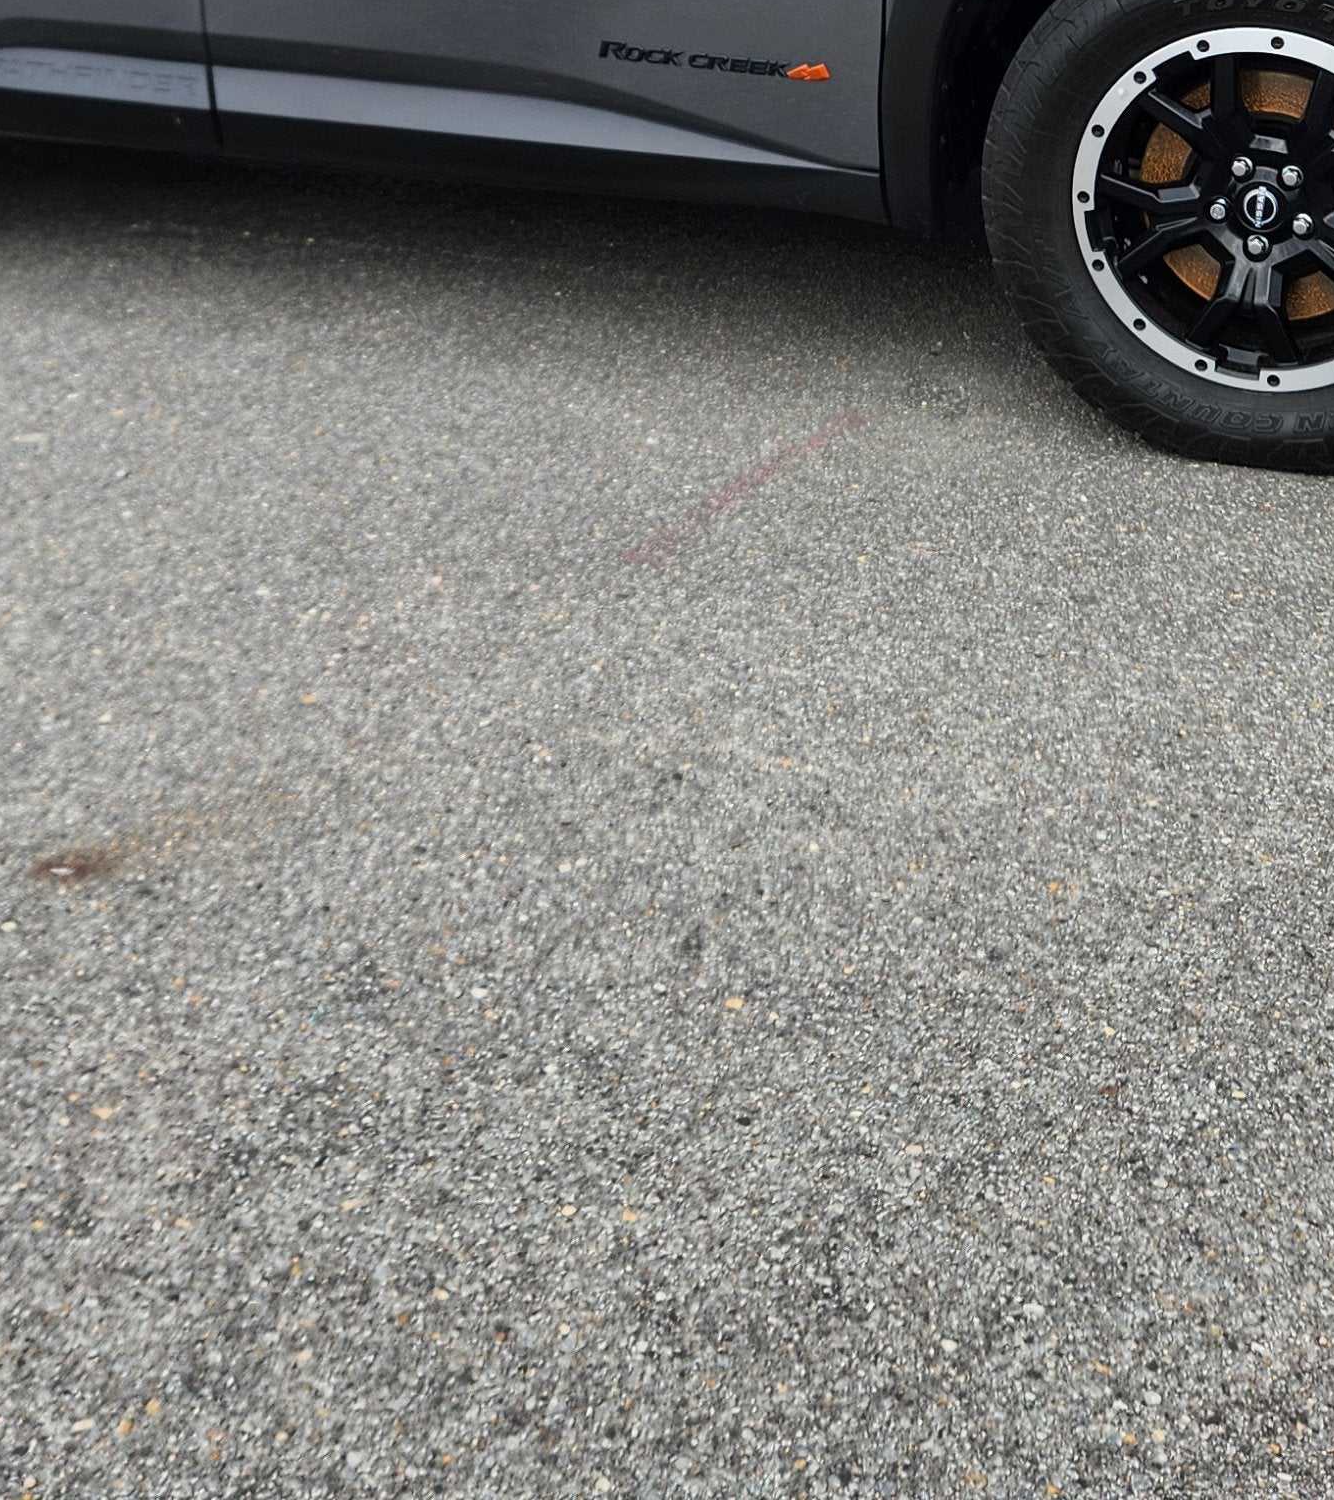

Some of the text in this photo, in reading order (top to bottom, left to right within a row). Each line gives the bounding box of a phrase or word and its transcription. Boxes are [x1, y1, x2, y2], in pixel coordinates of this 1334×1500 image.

[598, 39, 792, 78] ROCK CREEK
[1254, 185, 1267, 229] NISSAN
